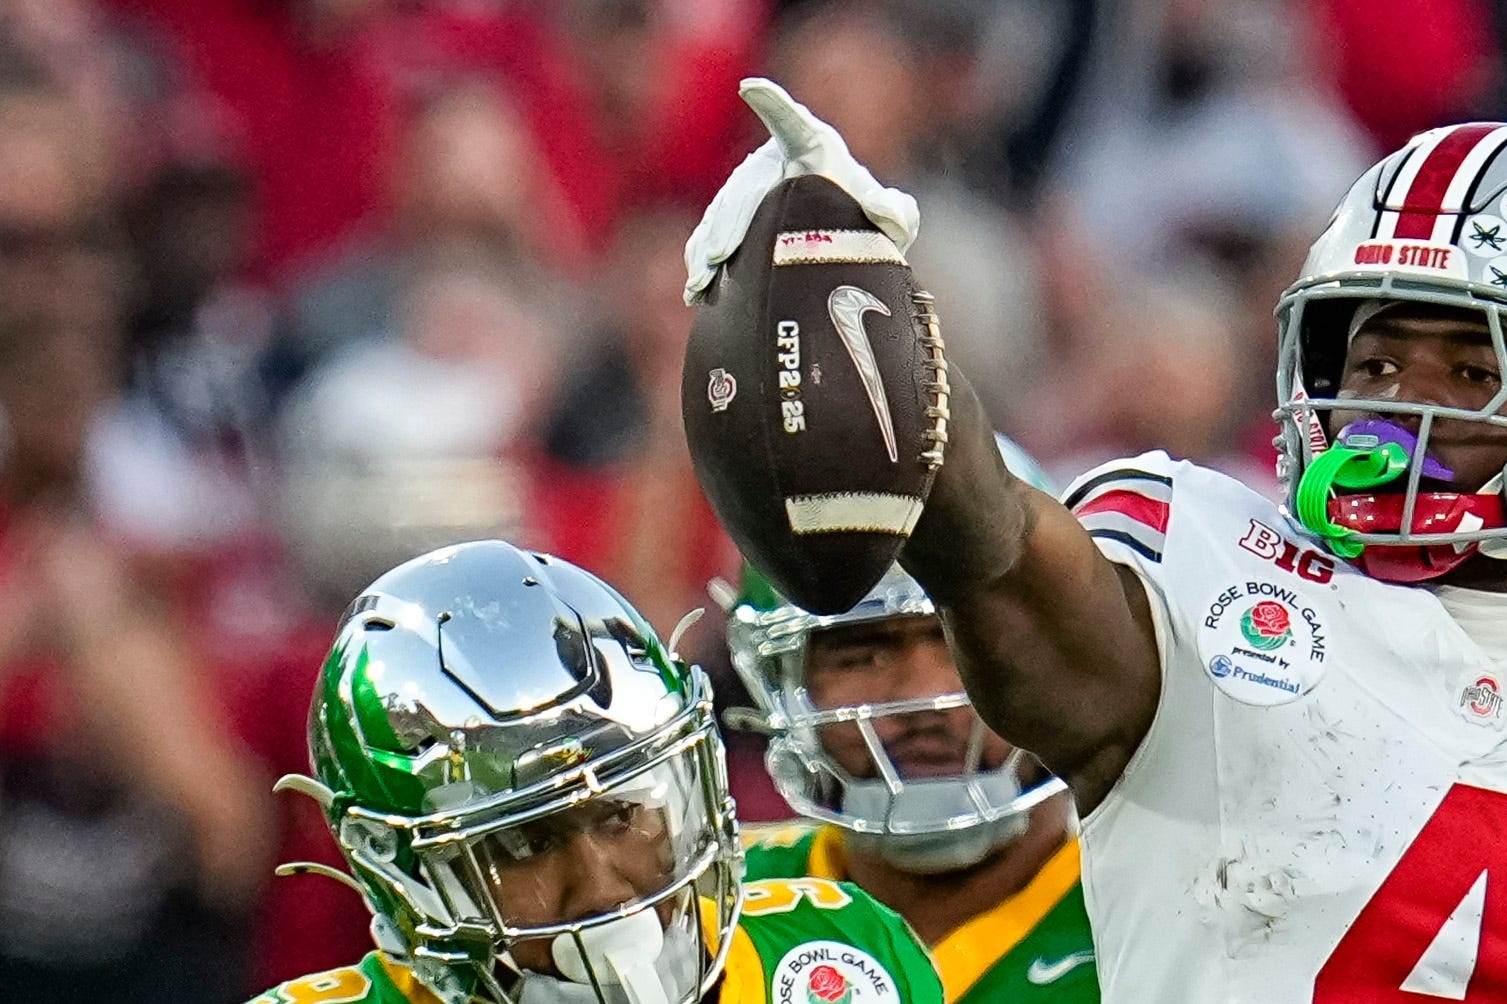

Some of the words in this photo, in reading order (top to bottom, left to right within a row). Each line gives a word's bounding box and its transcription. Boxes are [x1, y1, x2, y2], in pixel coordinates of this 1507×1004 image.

[1398, 245, 1451, 269] STATE
[1205, 586, 1243, 629] ROSE
[1246, 582, 1299, 610] BOWL
[1301, 607, 1326, 663] GAME
[1233, 666, 1300, 694] Prudential
[788, 949, 838, 974] BOWL
[840, 952, 889, 996] GAME
